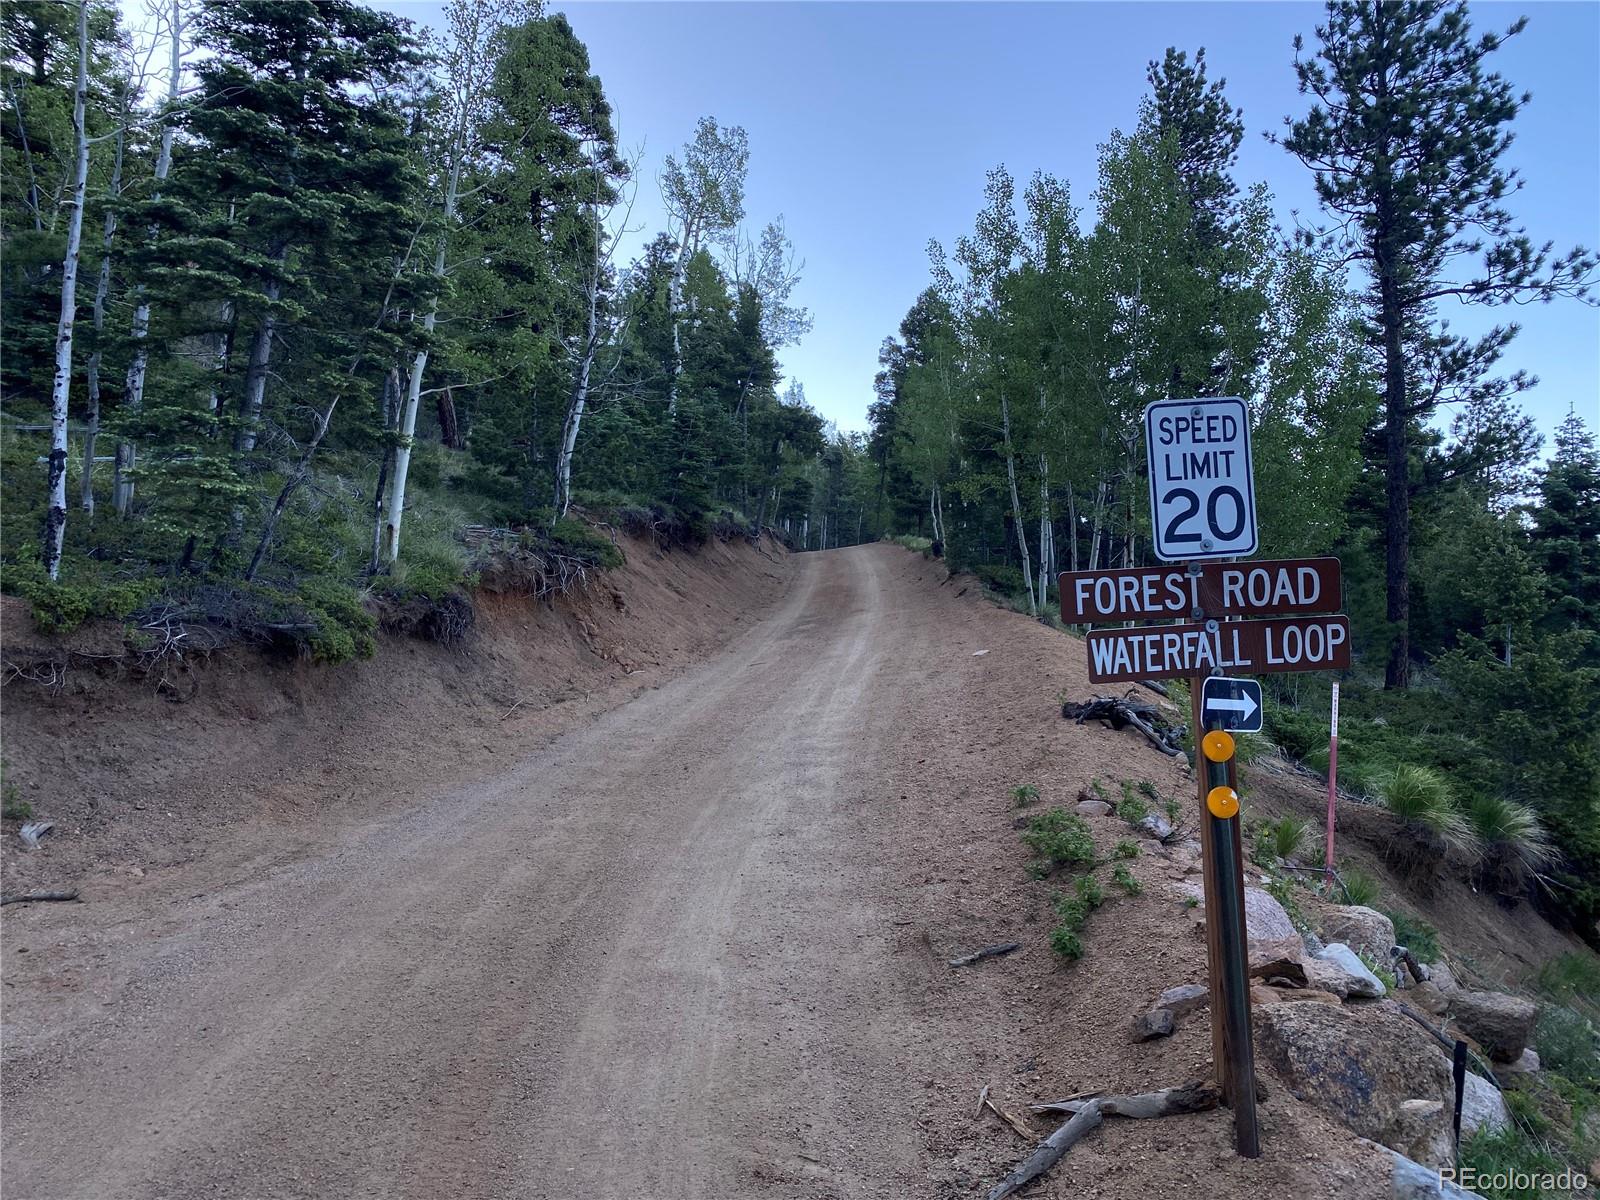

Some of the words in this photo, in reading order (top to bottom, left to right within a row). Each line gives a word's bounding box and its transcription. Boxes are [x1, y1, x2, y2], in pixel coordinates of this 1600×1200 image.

[1159, 415, 1237, 445] SPEED
[1165, 450, 1235, 481] LIMIT
[1162, 485, 1246, 543] 20
[1075, 572, 1203, 616] FOREST
[1222, 566, 1321, 608] ROAD
[1091, 629, 1252, 676] WATERFALL
[1265, 623, 1346, 665] LOOP
